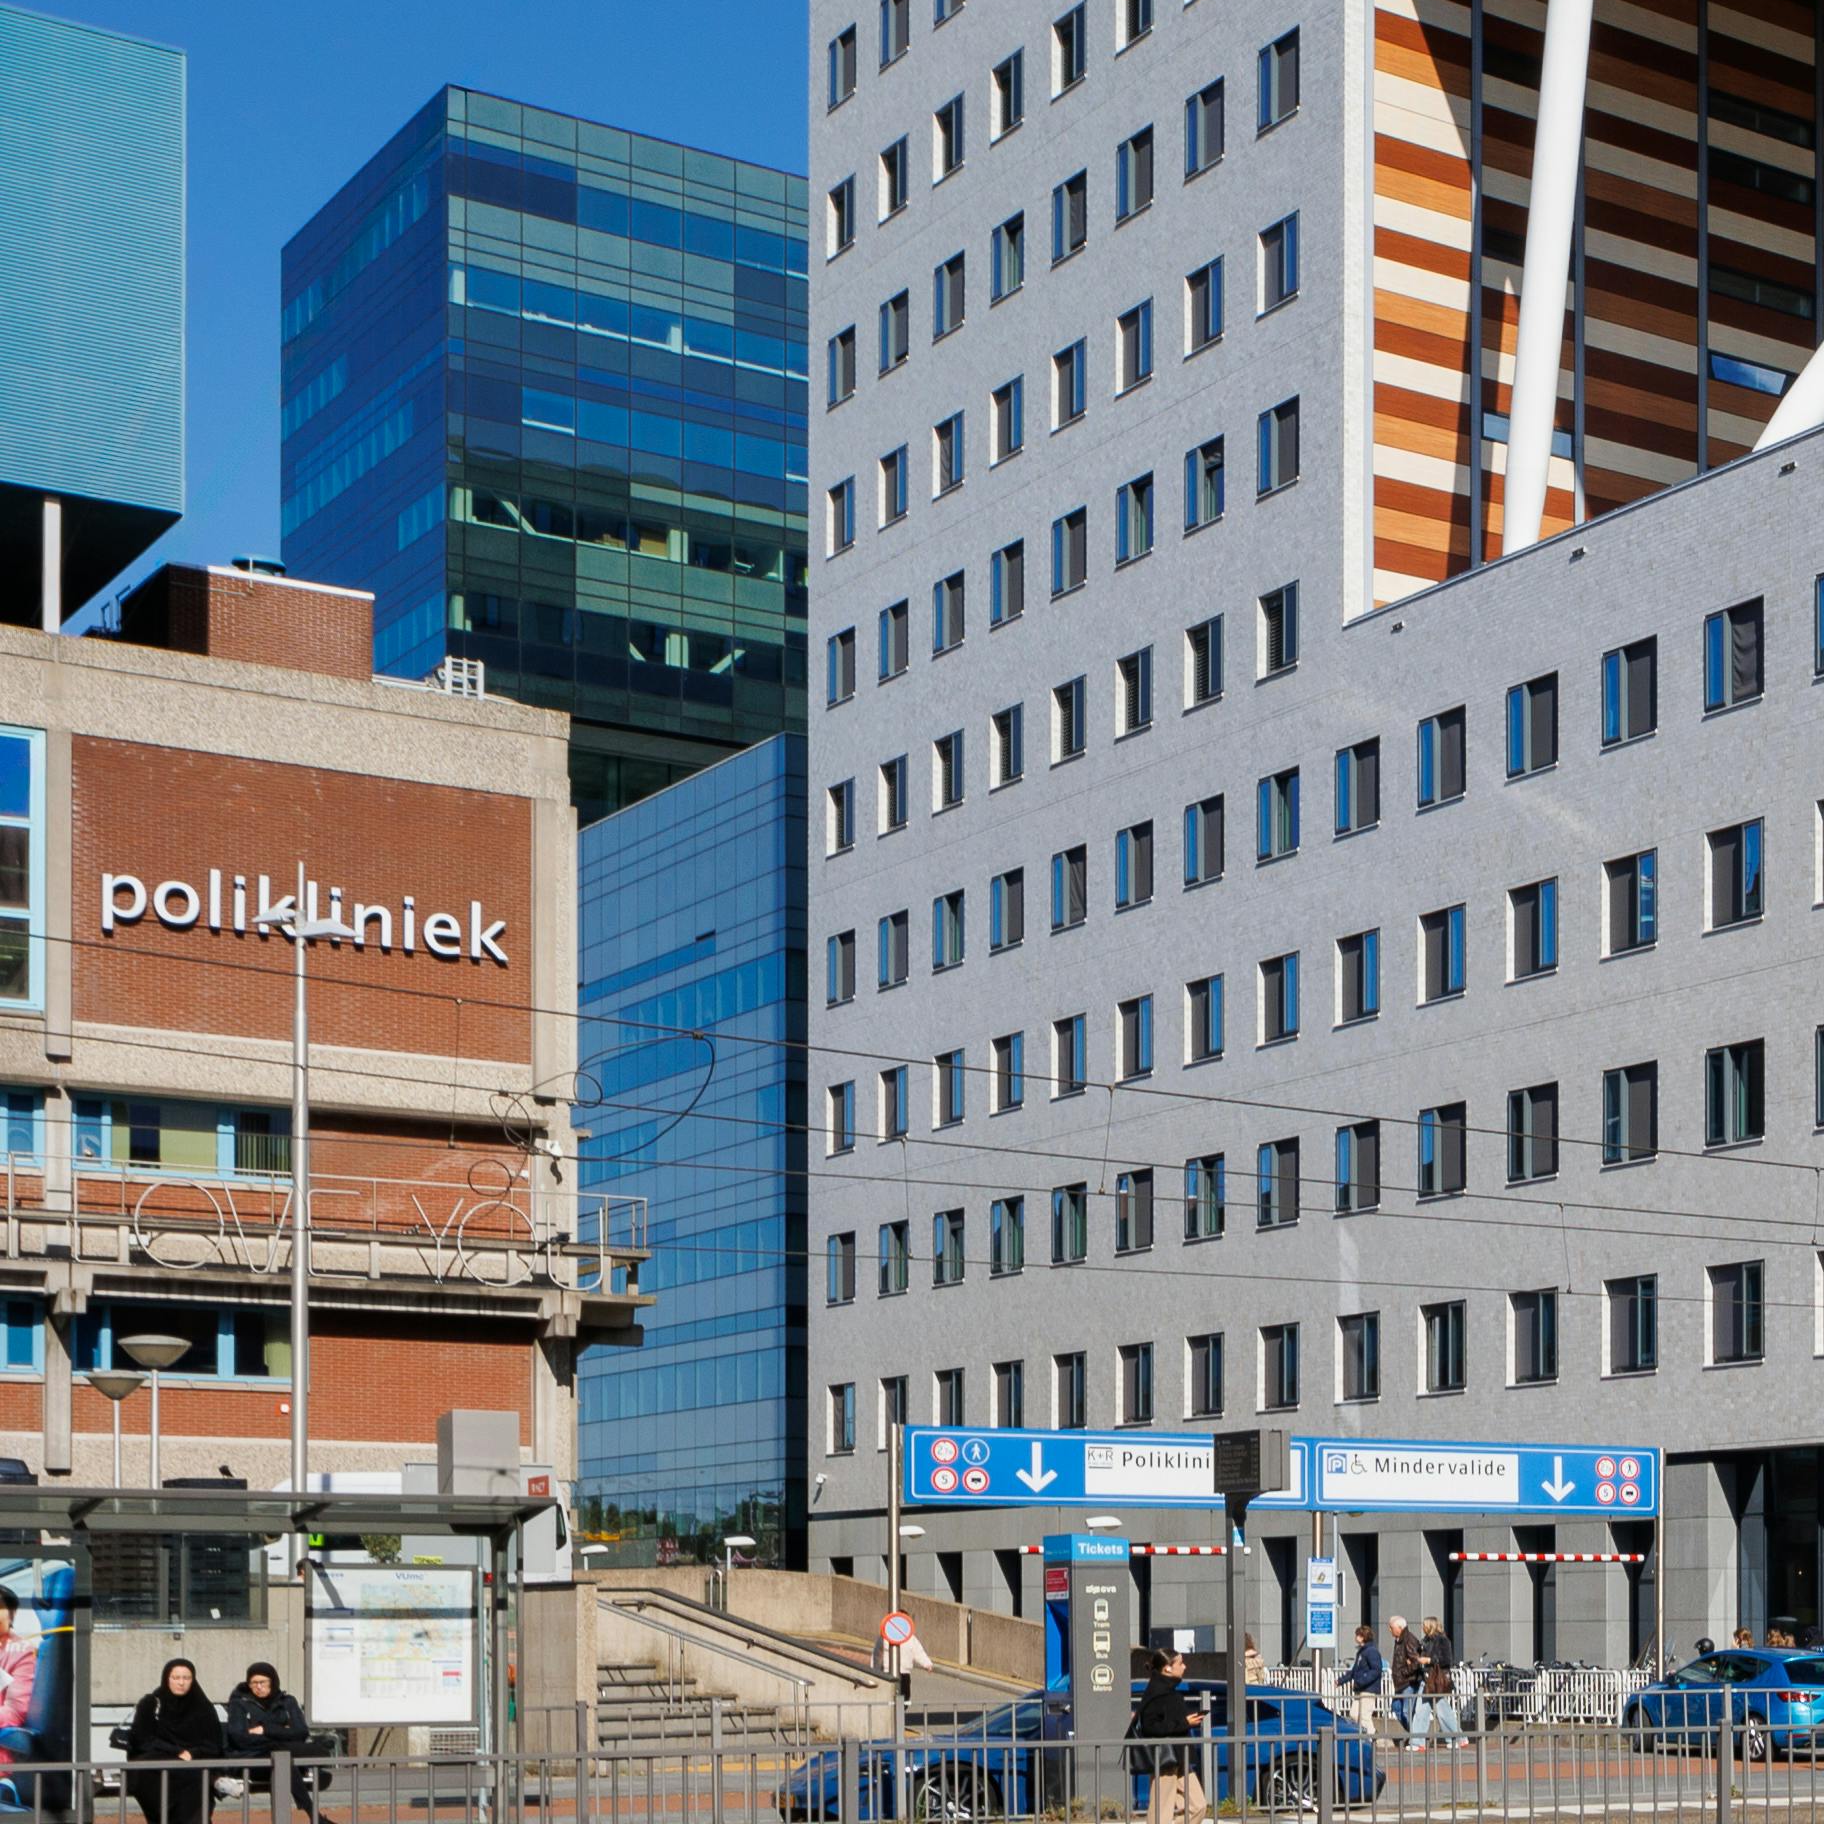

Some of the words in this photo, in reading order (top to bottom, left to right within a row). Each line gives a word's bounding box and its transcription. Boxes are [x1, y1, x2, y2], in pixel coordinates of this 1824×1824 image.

[101, 868, 508, 963] polikliniek
[73, 1171, 367, 1280] LOVE
[411, 1193, 605, 1292] YOU
[1122, 1451, 1210, 1468] Poliklini
[1375, 1457, 1506, 1476] Mindervalide
[1078, 1543, 1123, 1555] Tickets
